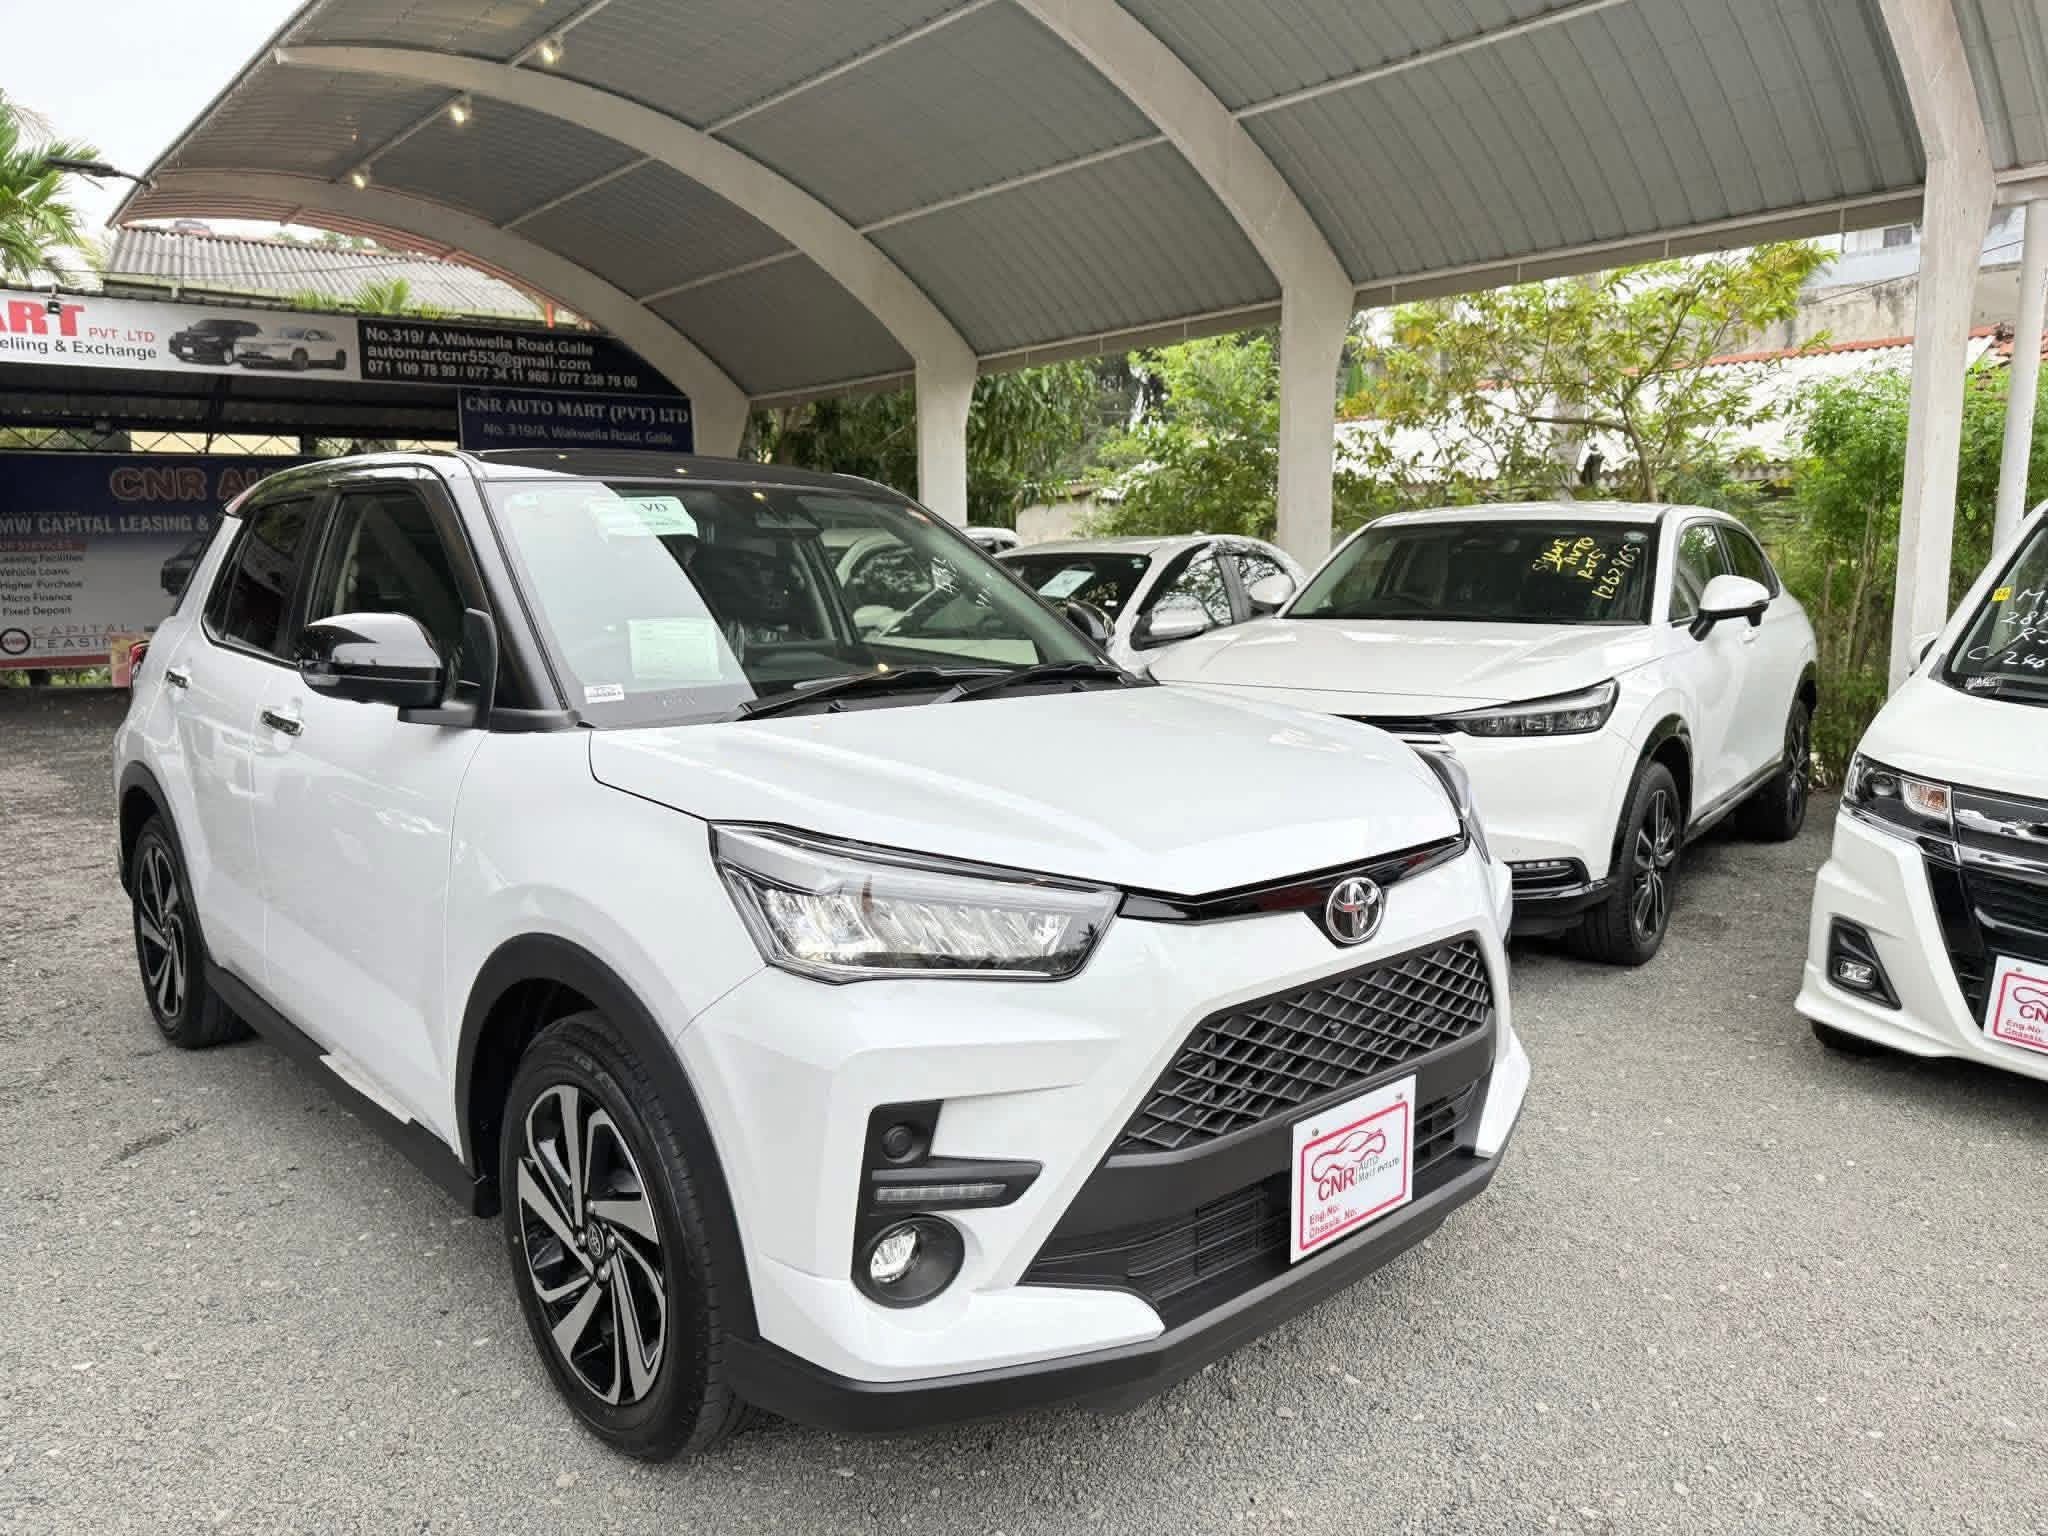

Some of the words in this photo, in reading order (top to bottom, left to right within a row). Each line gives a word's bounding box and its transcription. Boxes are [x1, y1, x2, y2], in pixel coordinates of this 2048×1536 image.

[0, 300, 85, 336] RT
[88, 327, 118, 339] PVT
[55, 339, 66, 353] &
[73, 341, 157, 360] Exchange
[465, 396, 502, 413] CNR
[503, 399, 553, 415] AUTO
[557, 403, 606, 418] MART
[609, 405, 655, 424] (PVT)
[658, 407, 689, 423] LTD
[110, 467, 208, 501] CNR
[38, 515, 113, 533] CAPITAL
[120, 515, 192, 533] LEASING
[1318, 1167, 1355, 1201] CNR
